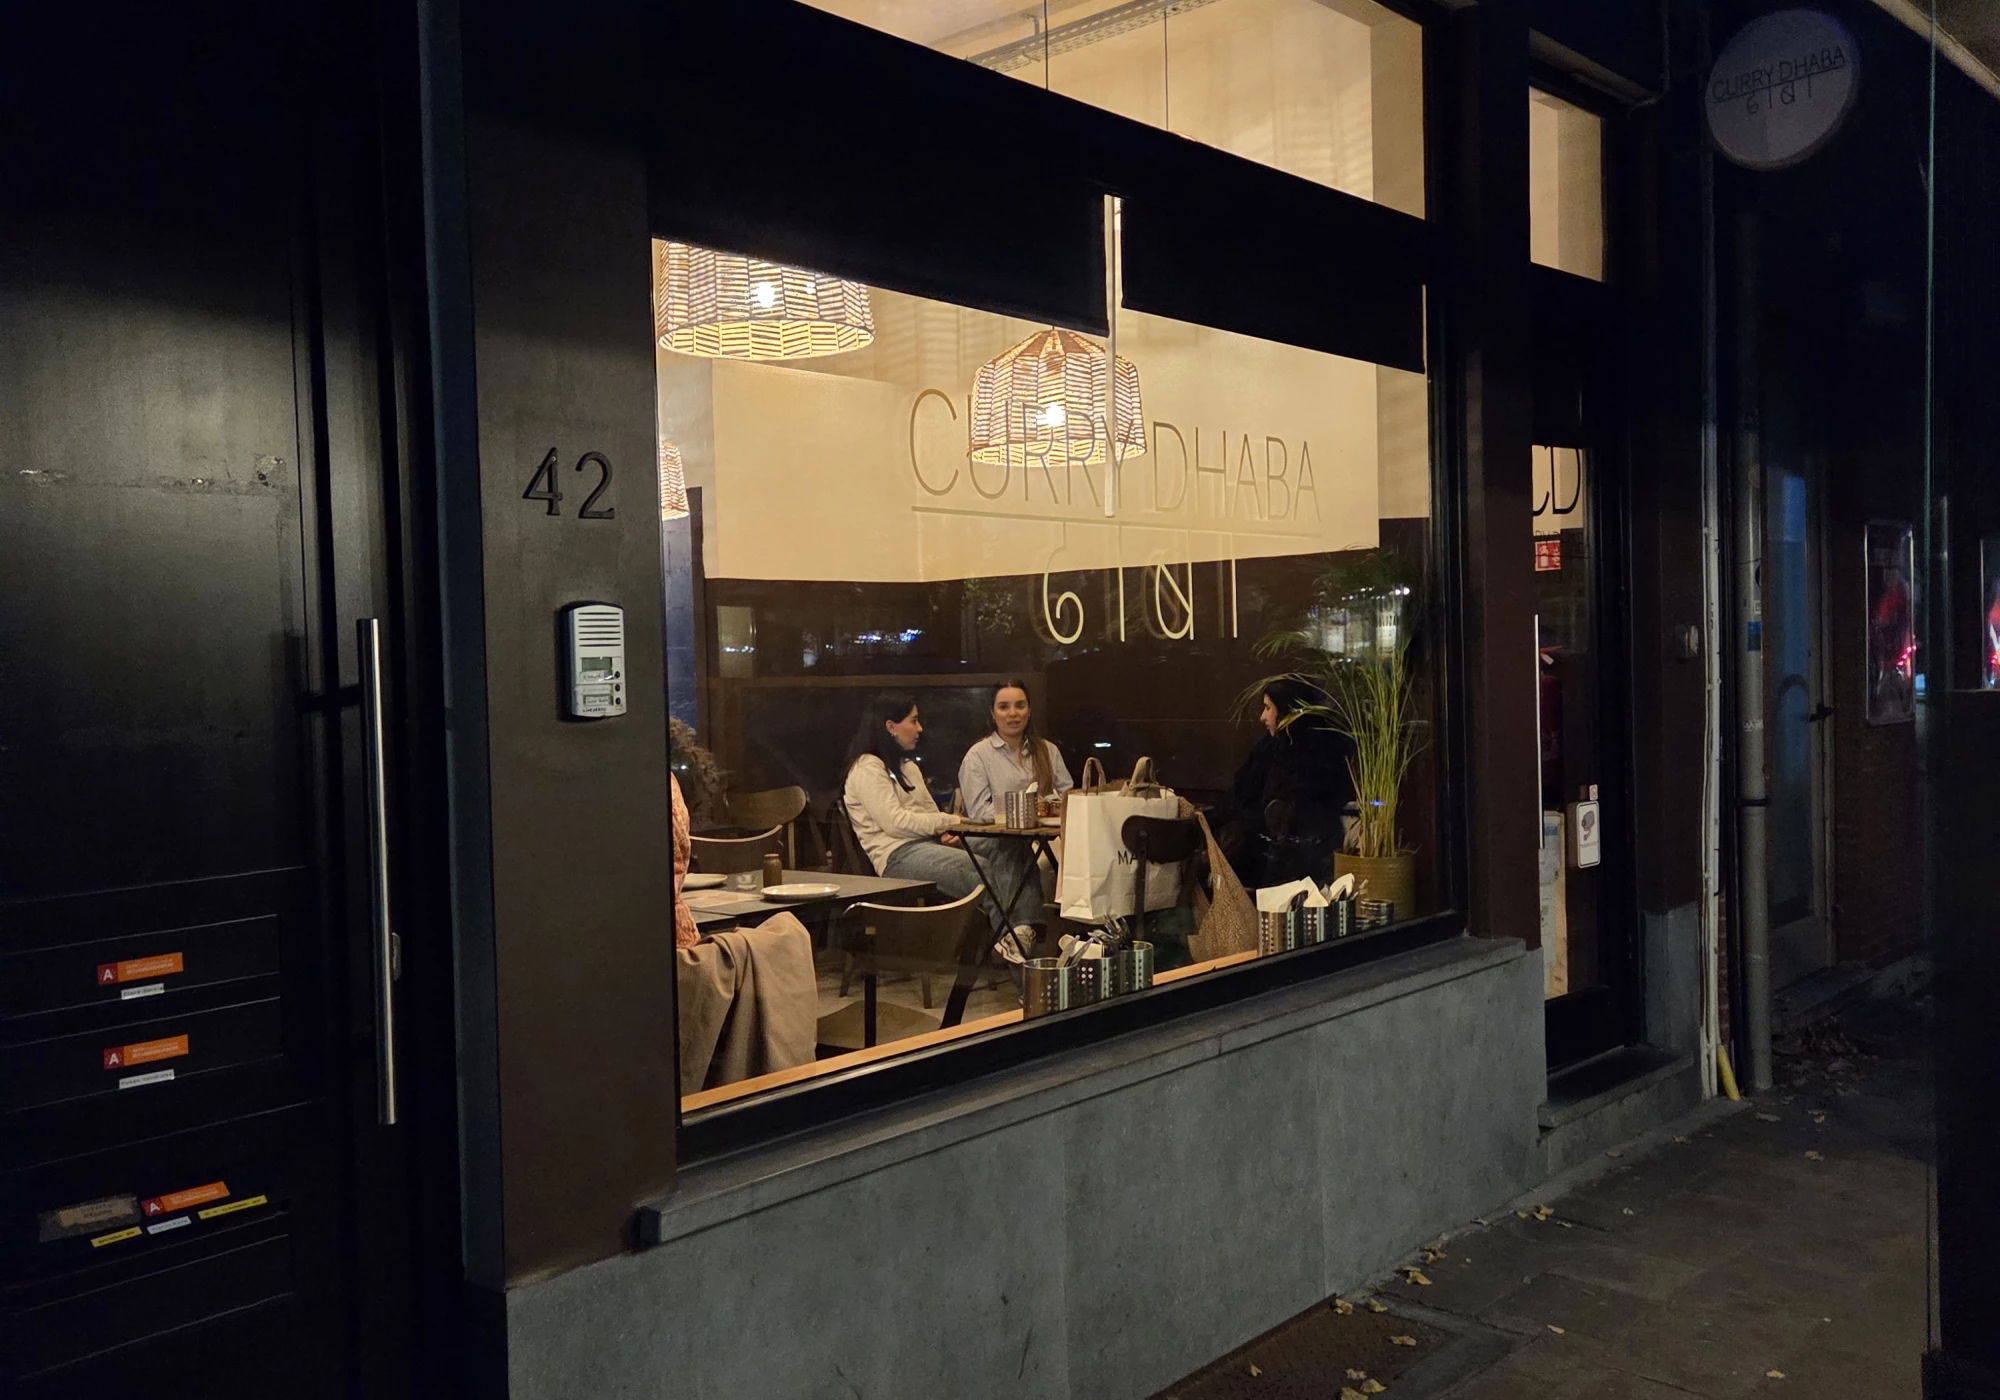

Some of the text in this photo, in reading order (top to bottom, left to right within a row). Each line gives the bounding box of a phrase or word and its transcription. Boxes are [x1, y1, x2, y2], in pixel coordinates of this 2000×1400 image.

[1712, 46, 1846, 100] CURRY DHABA
[522, 446, 616, 519] 42
[910, 388, 1322, 523] CURRY DHABA
